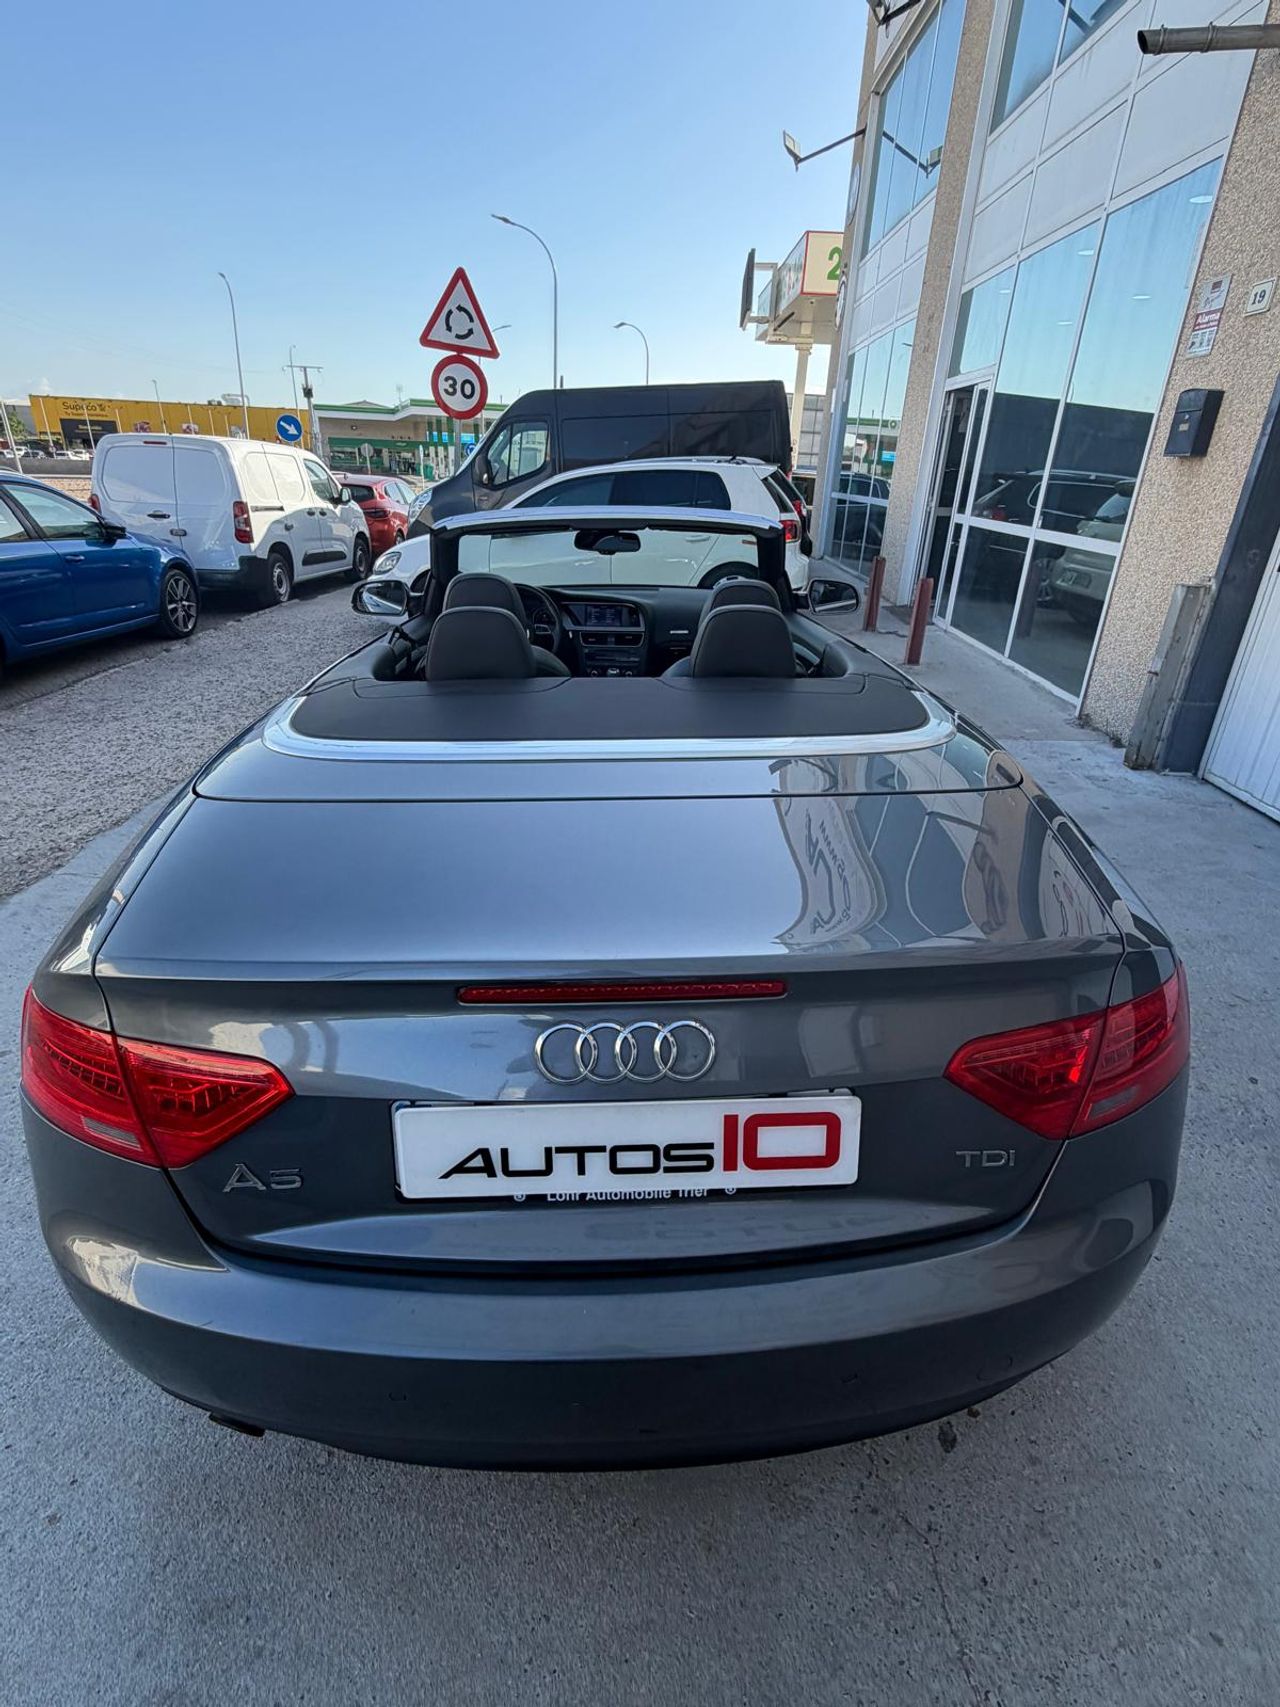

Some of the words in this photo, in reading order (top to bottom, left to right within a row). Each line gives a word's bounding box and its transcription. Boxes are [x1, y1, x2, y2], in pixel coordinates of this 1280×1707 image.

[1251, 289, 1266, 305] 19
[443, 375, 476, 399] 30
[222, 1162, 304, 1193] A5
